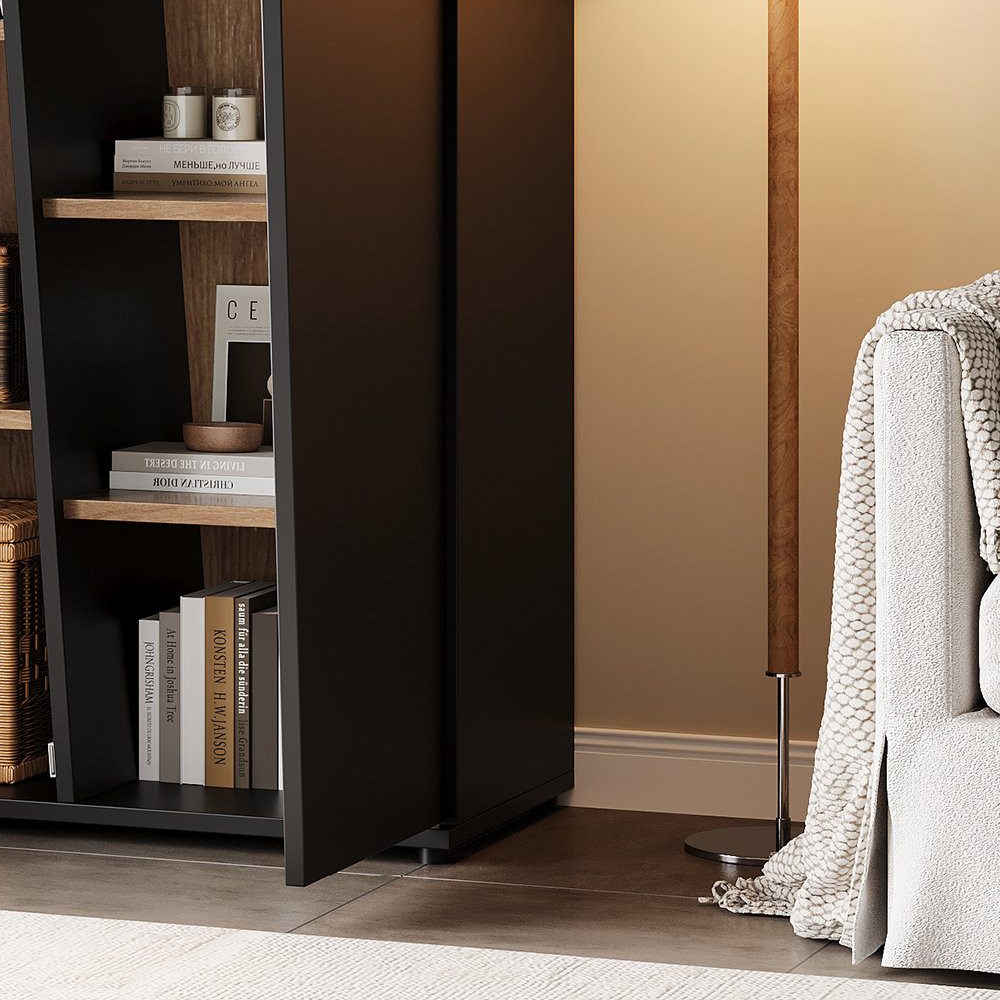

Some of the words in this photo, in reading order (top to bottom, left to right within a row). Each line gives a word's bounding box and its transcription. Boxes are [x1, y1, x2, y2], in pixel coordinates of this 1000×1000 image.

[228, 161, 261, 171] ЛУЧШЕ
[234, 179, 259, 188] АНГЕЛ
[237, 603, 246, 625] saum
[166, 628, 176, 639] At
[166, 641, 176, 664] Home
[213, 629, 226, 685] KONSTEN
[238, 642, 249, 659] alla
[166, 665, 176, 674] in
[238, 660, 249, 674] die
[163, 674, 178, 703] Joshua
[238, 676, 249, 714] sünderin
[166, 705, 176, 724] Tree
